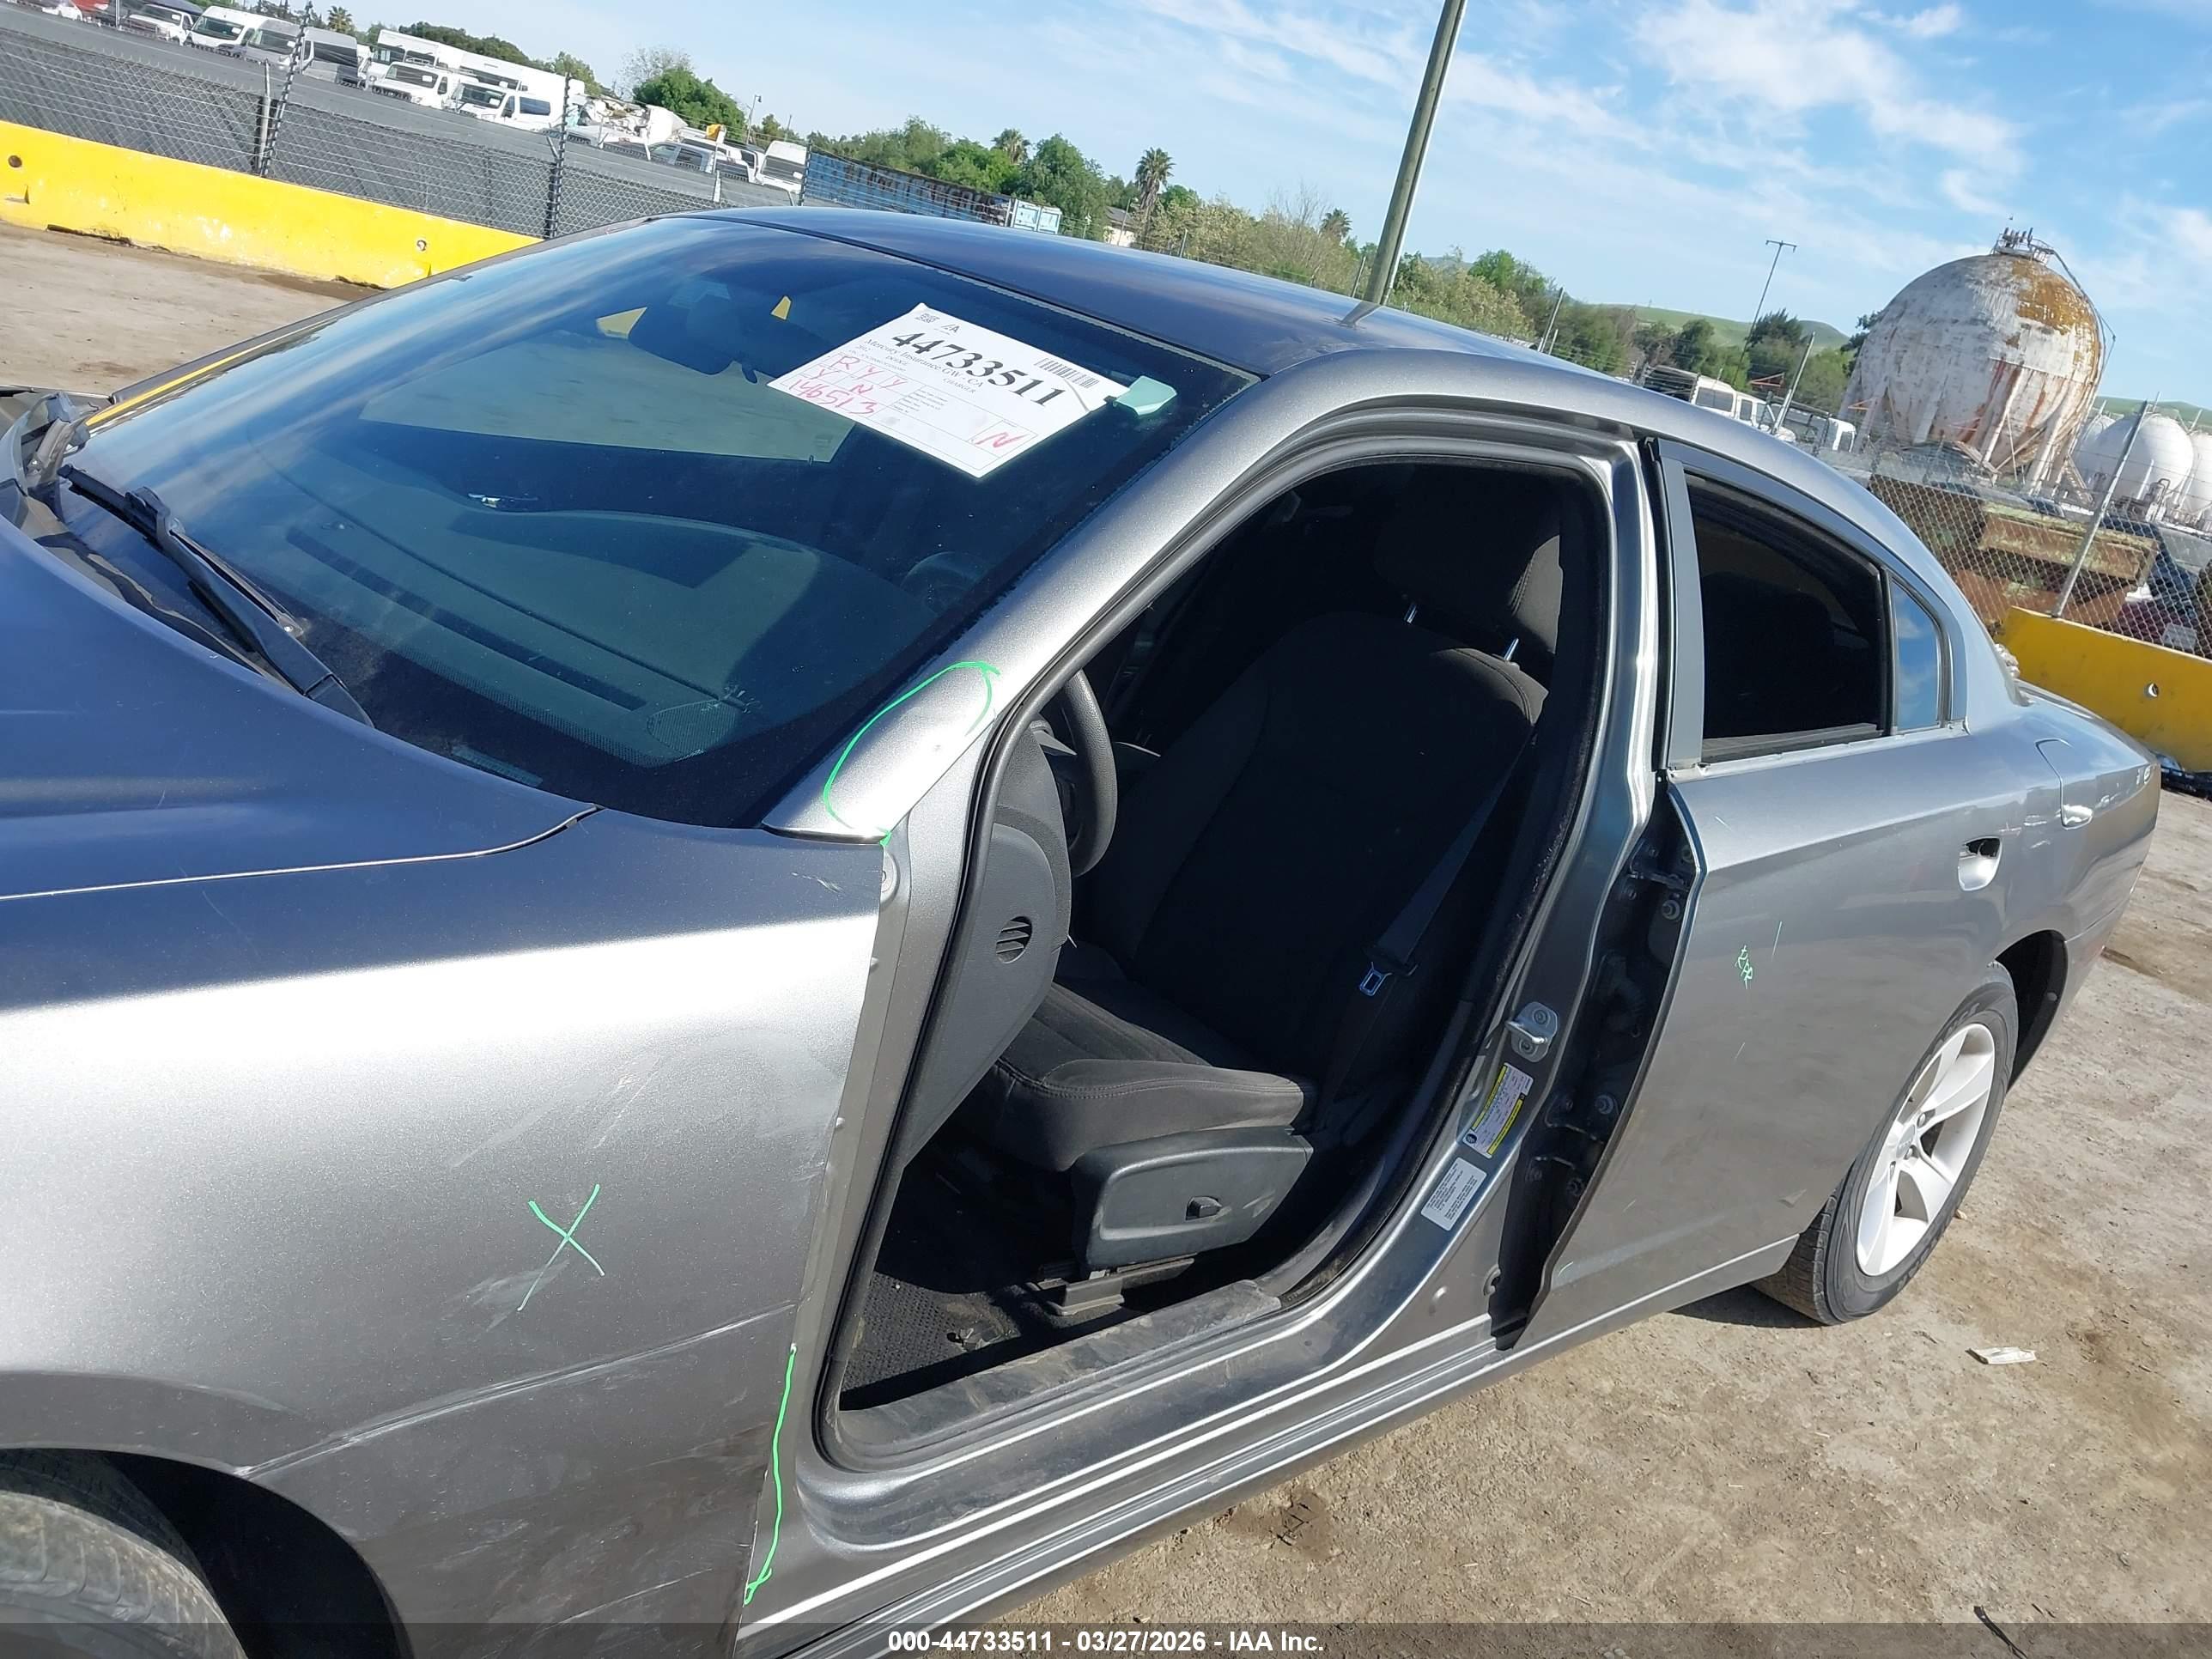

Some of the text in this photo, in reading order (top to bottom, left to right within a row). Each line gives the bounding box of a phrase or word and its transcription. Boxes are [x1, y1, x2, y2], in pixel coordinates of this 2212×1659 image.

[900, 351, 942, 370] Insurance
[891, 332, 1066, 407] 44733511
[848, 384, 874, 394] N
[943, 378, 976, 393] CHARGER
[975, 431, 1020, 448] N
